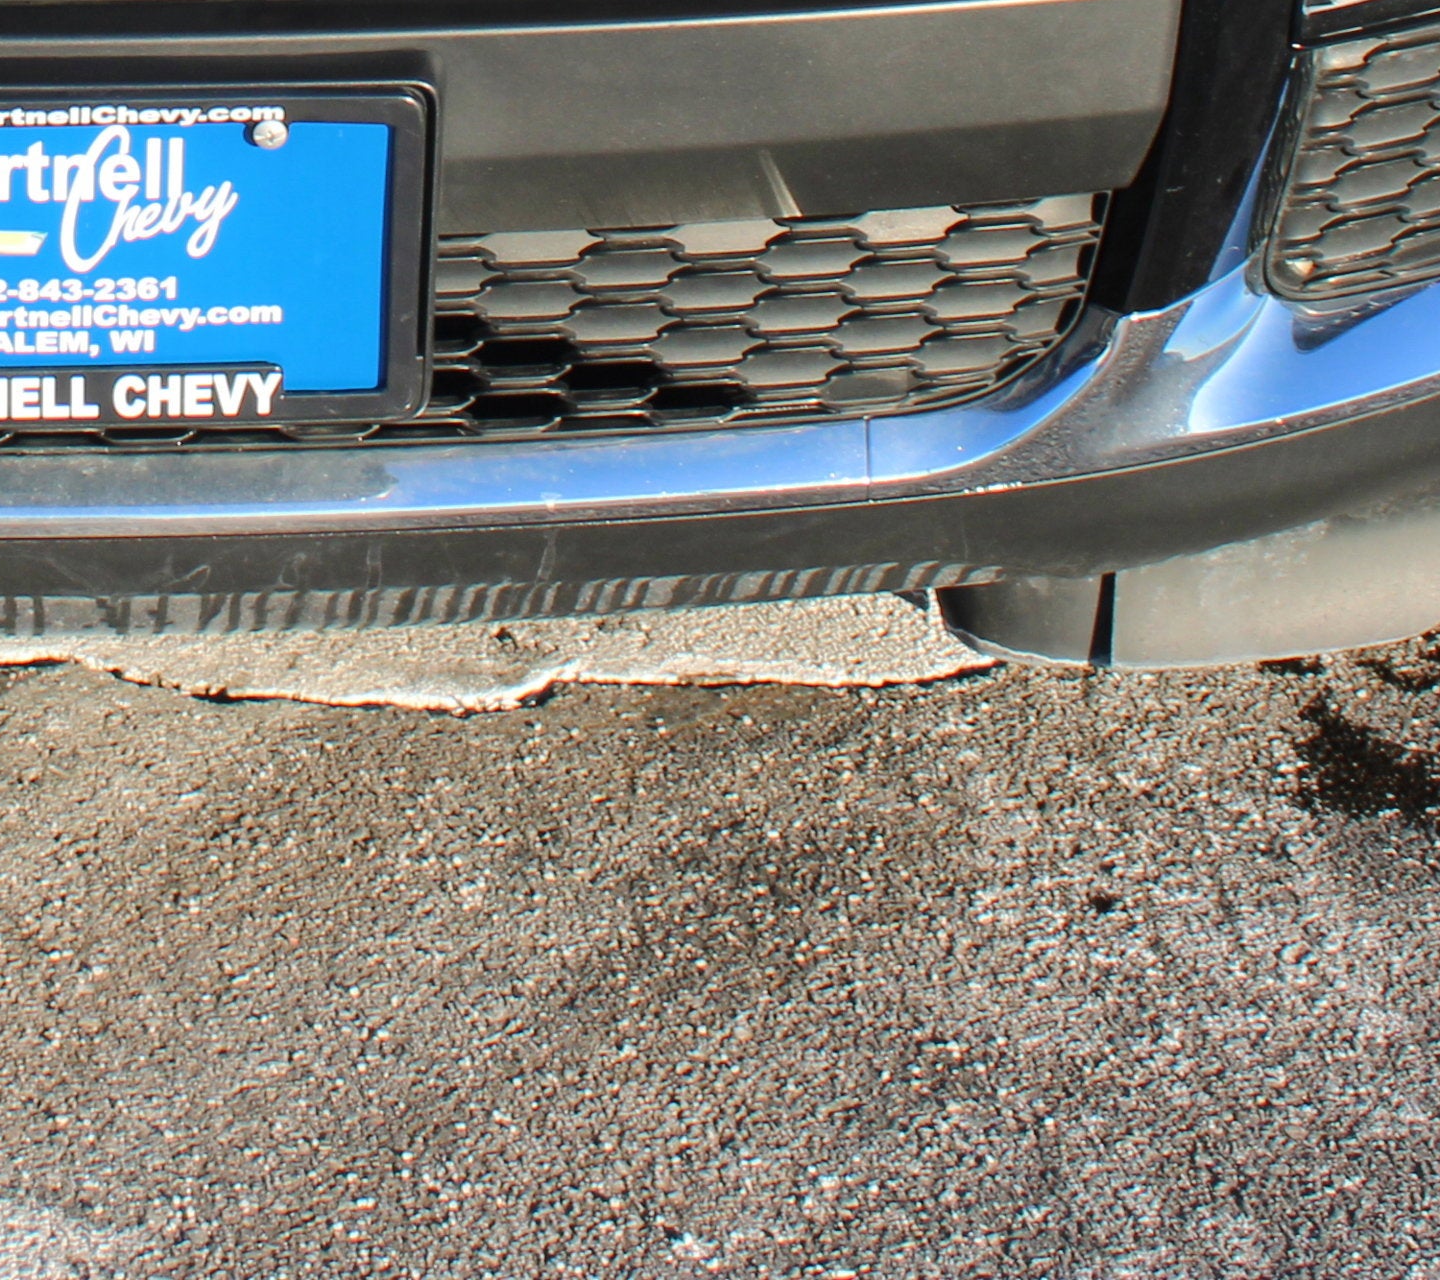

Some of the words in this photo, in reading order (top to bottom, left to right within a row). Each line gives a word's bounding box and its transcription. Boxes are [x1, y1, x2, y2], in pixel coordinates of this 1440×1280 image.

[59, 124, 239, 273] Chevy
[109, 329, 156, 353] WI
[112, 371, 284, 419] CHEVY
